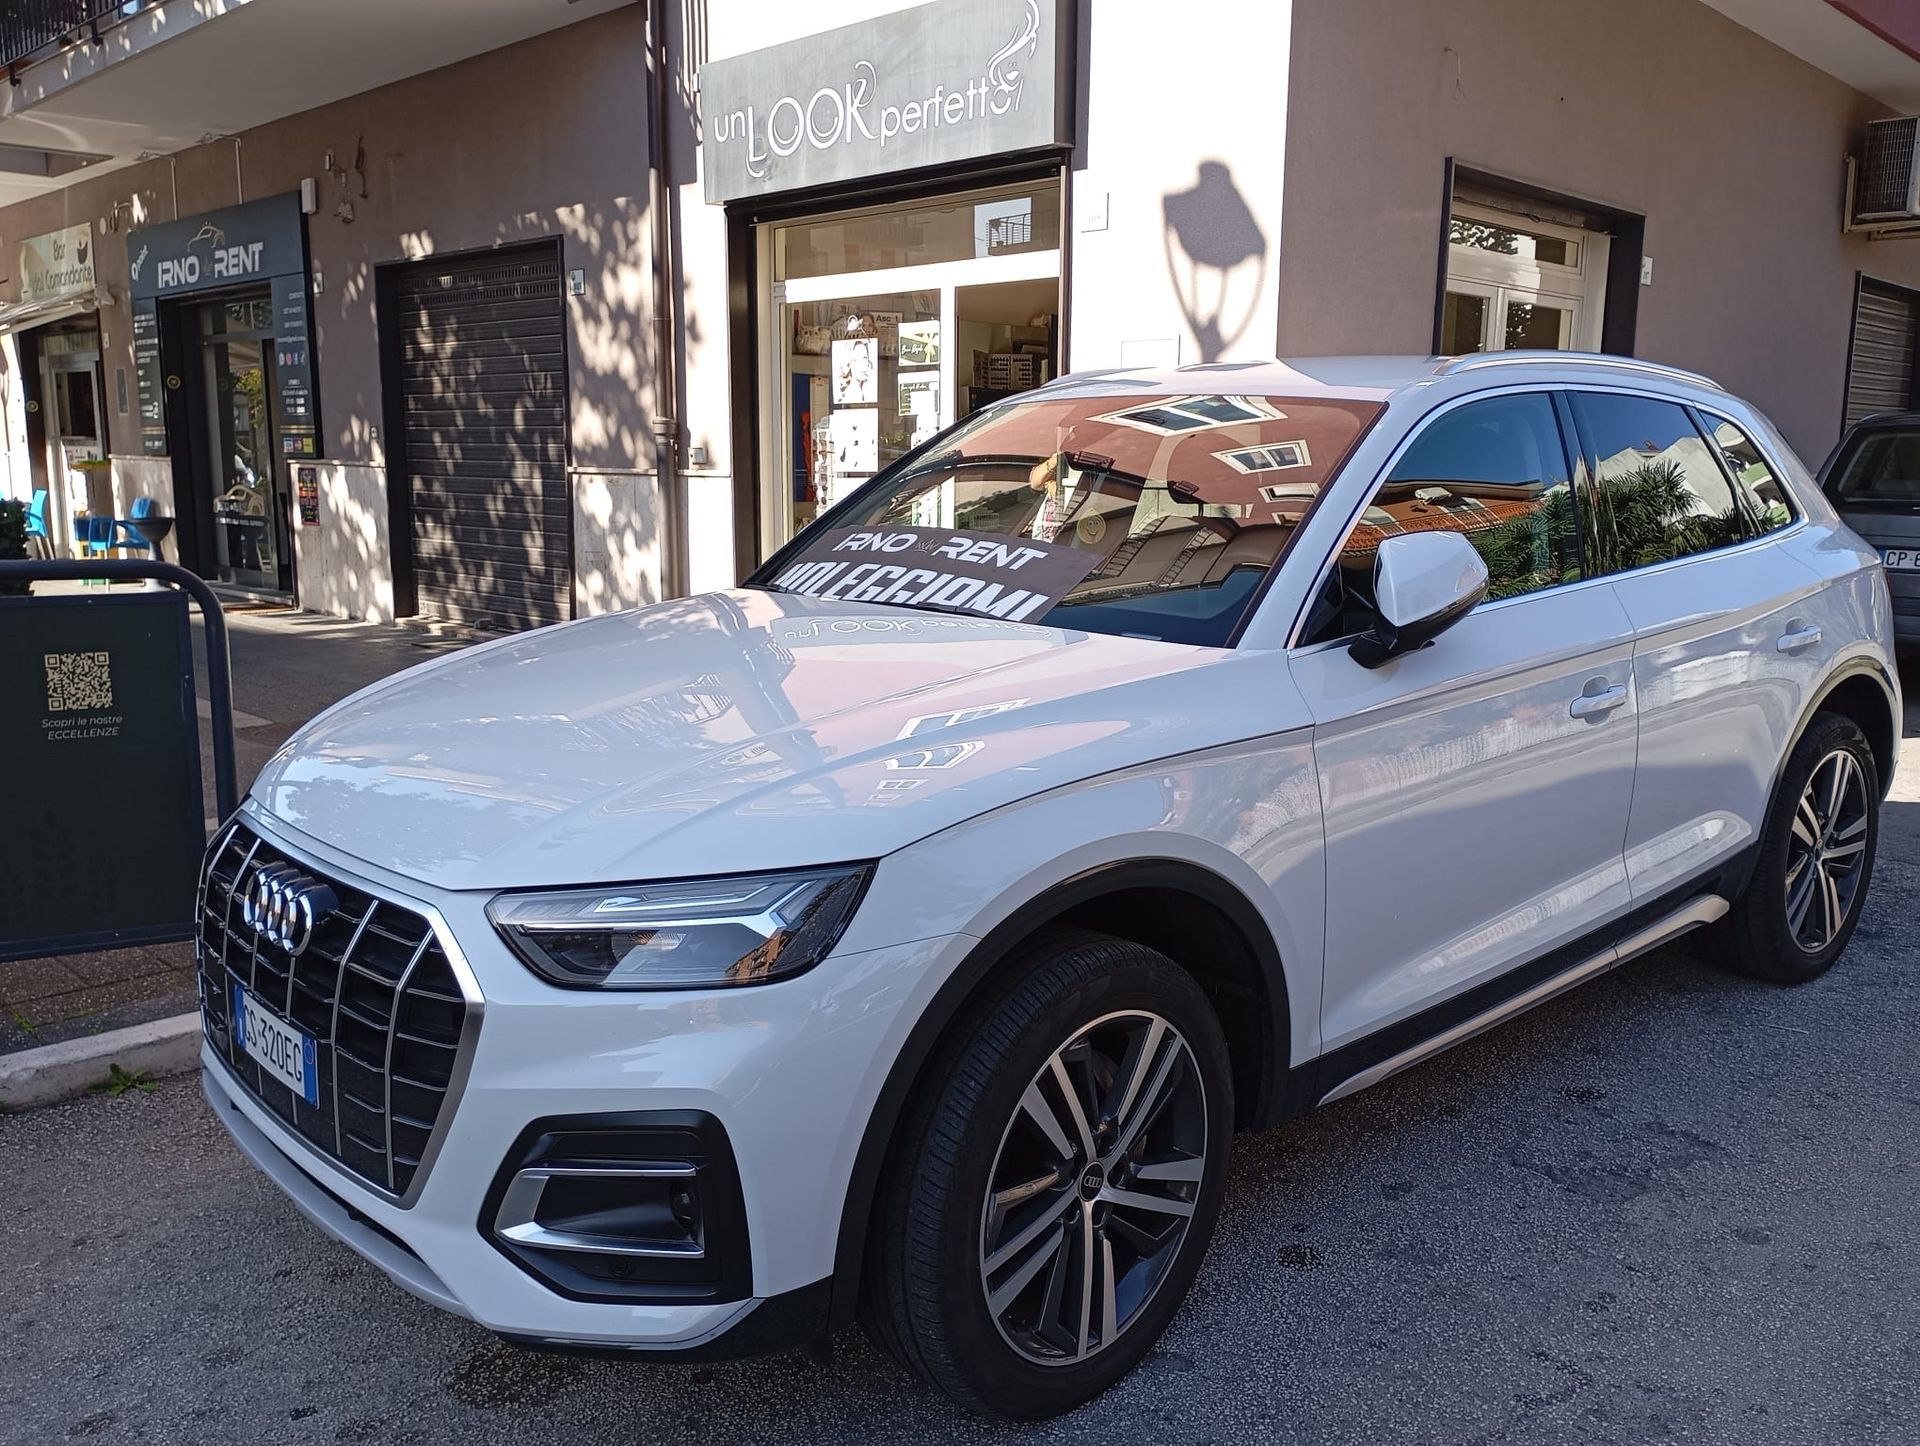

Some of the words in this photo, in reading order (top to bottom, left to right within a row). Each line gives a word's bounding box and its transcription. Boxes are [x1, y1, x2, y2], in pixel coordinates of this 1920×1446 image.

[714, 110, 746, 143] un
[745, 60, 880, 178] LOOK
[880, 76, 1026, 147] perfetto
[53, 239, 66, 261] Bar
[158, 255, 200, 289] IRNO
[214, 241, 264, 279] RENT
[833, 533, 918, 553] IRNO
[931, 537, 1049, 571] RENT
[1886, 551, 1908, 566] CP
[41, 717, 75, 729] Scopri
[77, 716, 87, 726] le
[89, 716, 123, 726] nostre
[47, 726, 120, 740] ECCELLENZE
[259, 1017, 303, 1083] 320EG
